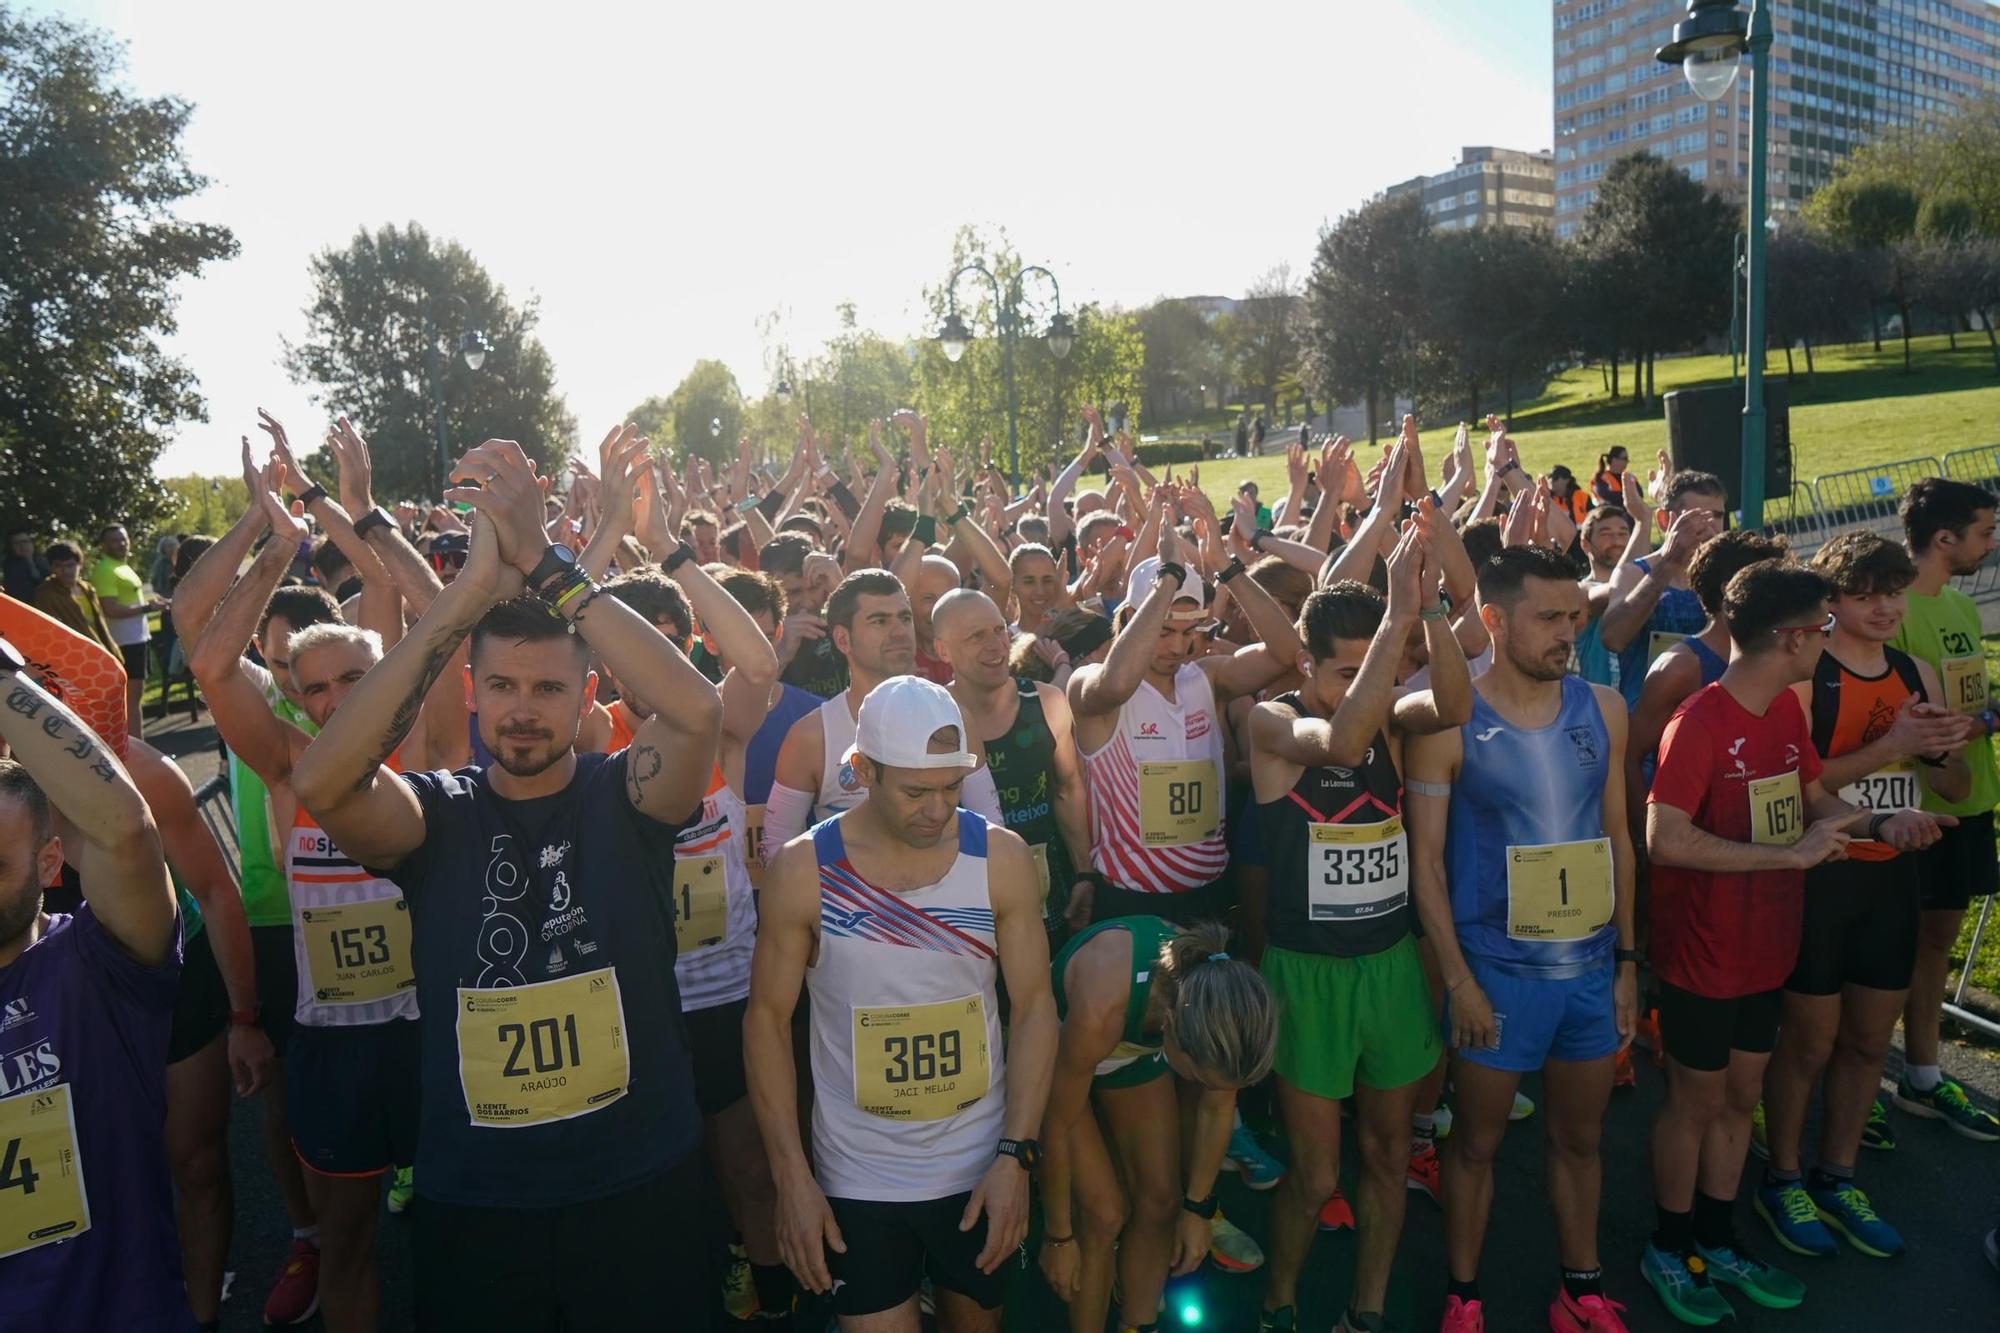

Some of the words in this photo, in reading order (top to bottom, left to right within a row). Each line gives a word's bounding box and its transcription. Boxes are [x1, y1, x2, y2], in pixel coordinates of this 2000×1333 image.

[1959, 672, 1985, 705] 1518
[1168, 781, 1202, 815] 80
[1855, 775, 1915, 810] 3201
[1323, 841, 1399, 885] 3335
[1558, 868, 1568, 905] 1
[1547, 908, 1583, 918] PRESEDO
[330, 924, 390, 969] 153
[360, 965, 396, 980] CARLOS
[498, 1014, 581, 1078] 201
[884, 1029, 962, 1083] 369
[520, 1077, 567, 1093] ARAÚJO
[893, 1087, 919, 1098] JACI
[924, 1082, 956, 1095] MELLO
[493, 1107, 529, 1116] BARRIOS
